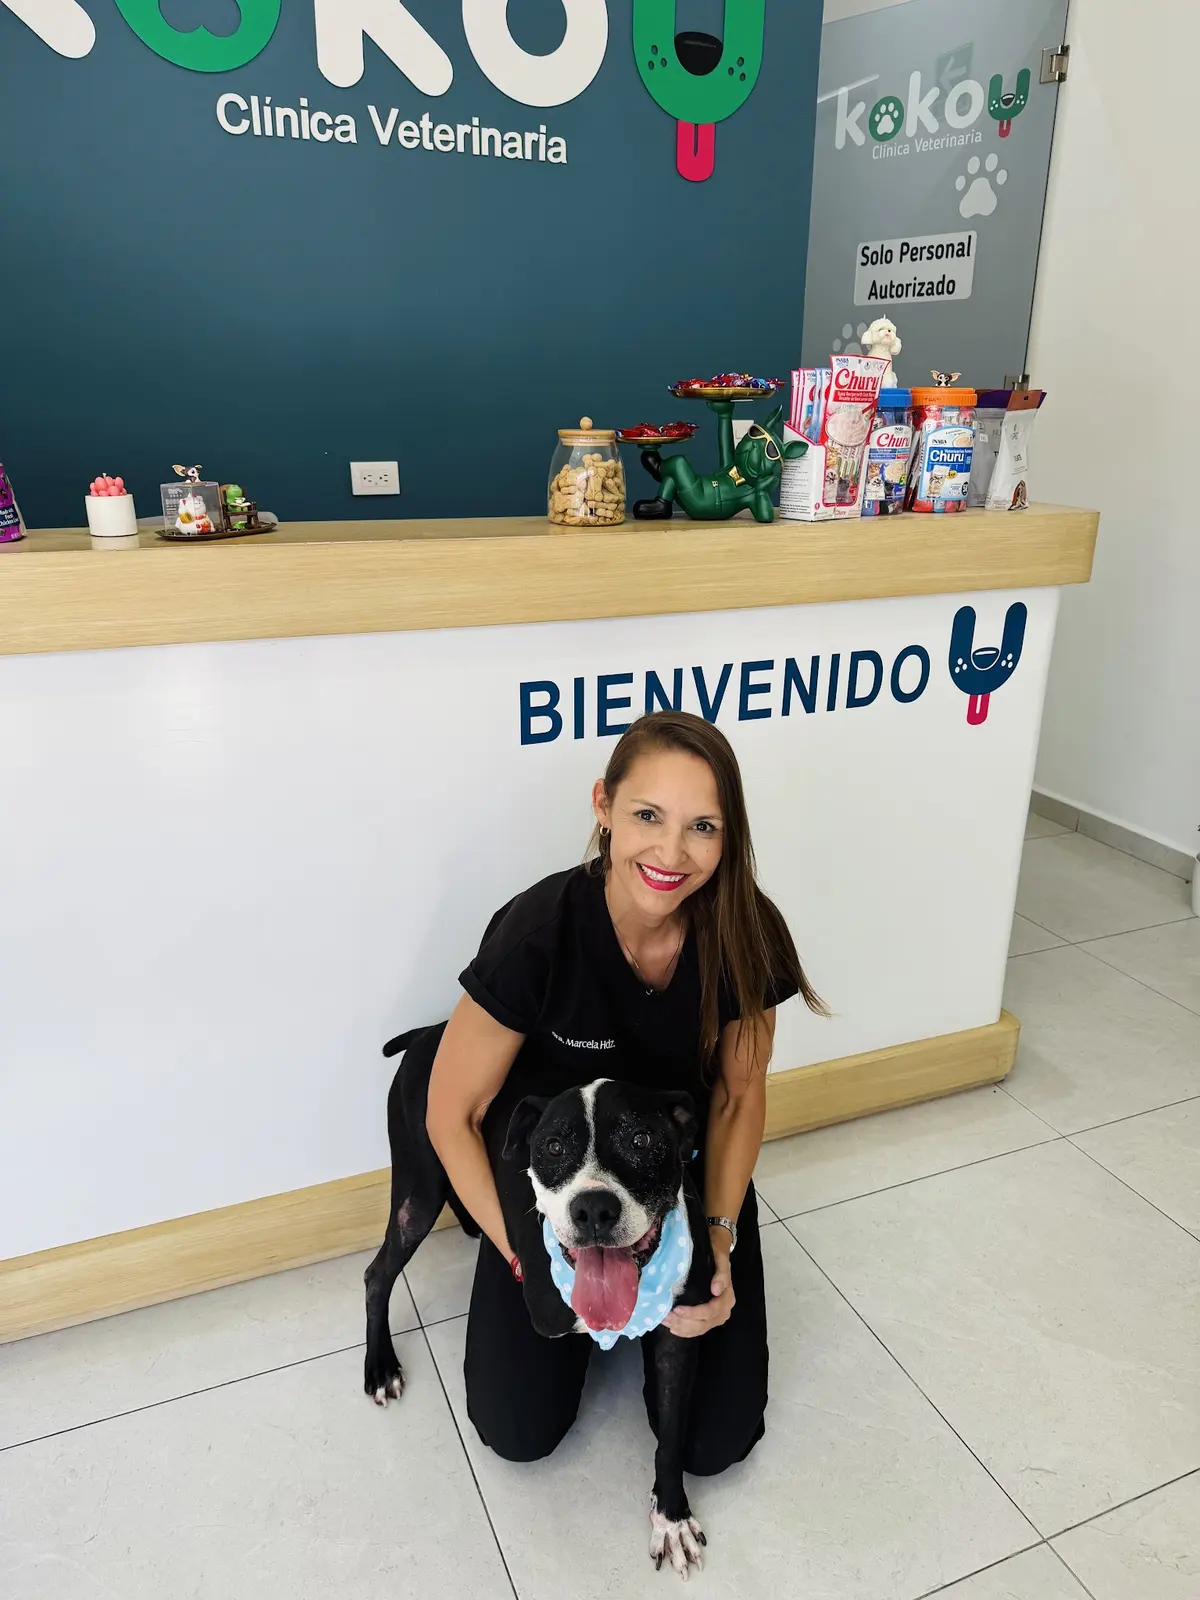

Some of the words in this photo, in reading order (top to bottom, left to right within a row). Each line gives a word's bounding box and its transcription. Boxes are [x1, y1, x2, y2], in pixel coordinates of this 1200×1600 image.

[216, 92, 357, 144] Clínica
[367, 105, 568, 164] Veterinaria
[872, 141, 910, 160] Clínica
[914, 131, 982, 152] Veterinaria
[860, 246, 894, 267] Solo
[899, 235, 972, 263] Personal
[868, 275, 956, 301] Autorizado
[834, 368, 880, 390] Churu
[929, 449, 965, 463] Churu
[519, 644, 931, 746] BIENVENIDO
[565, 1038, 600, 1050] Marcela
[599, 1038, 616, 1050] Hdz.
